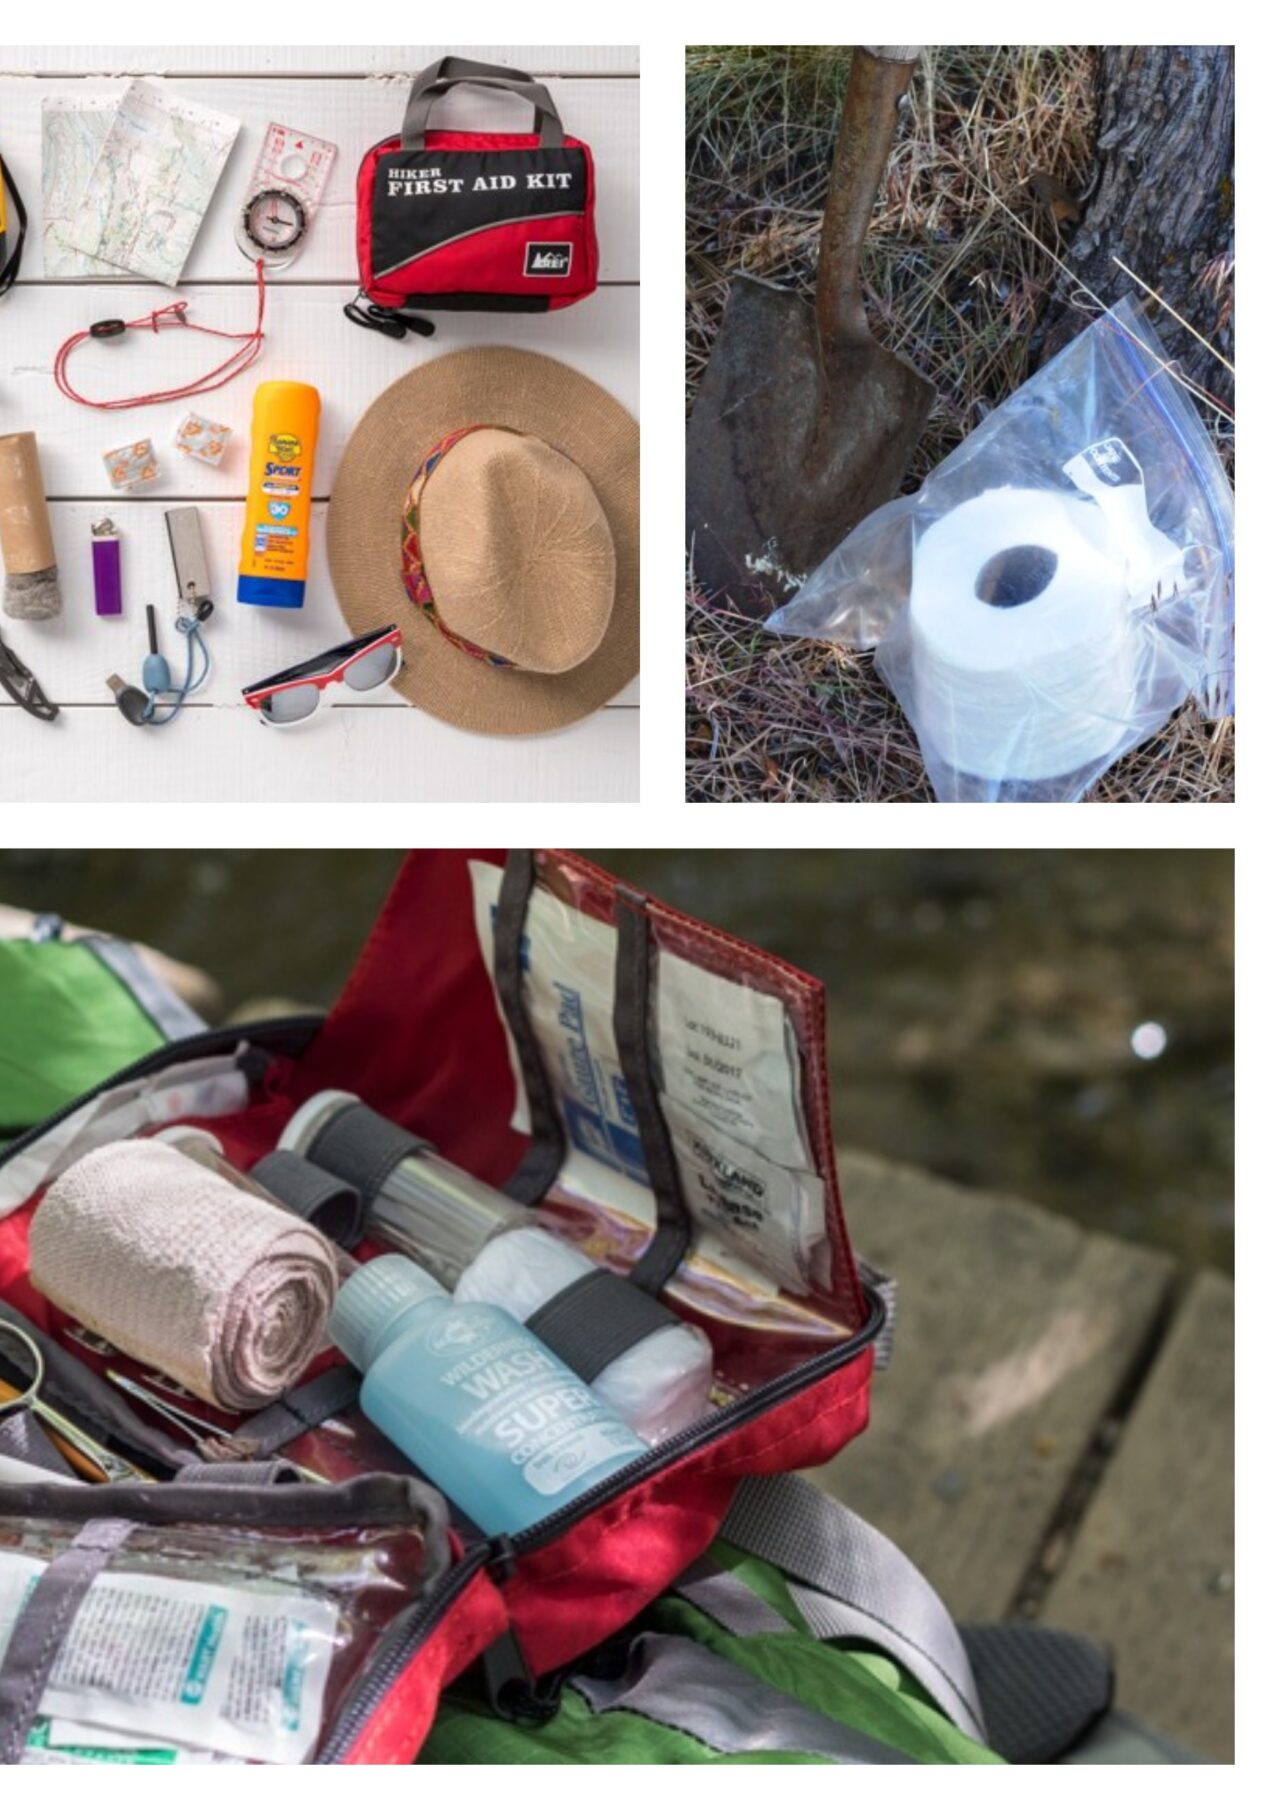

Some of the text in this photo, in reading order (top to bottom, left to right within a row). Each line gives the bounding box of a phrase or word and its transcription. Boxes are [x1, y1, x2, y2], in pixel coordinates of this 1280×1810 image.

[387, 172, 573, 197] FIRST AID KIT
[388, 168, 442, 180] HIKER
[461, 1349, 556, 1400] WASH
[495, 1386, 600, 1448] SUPER
